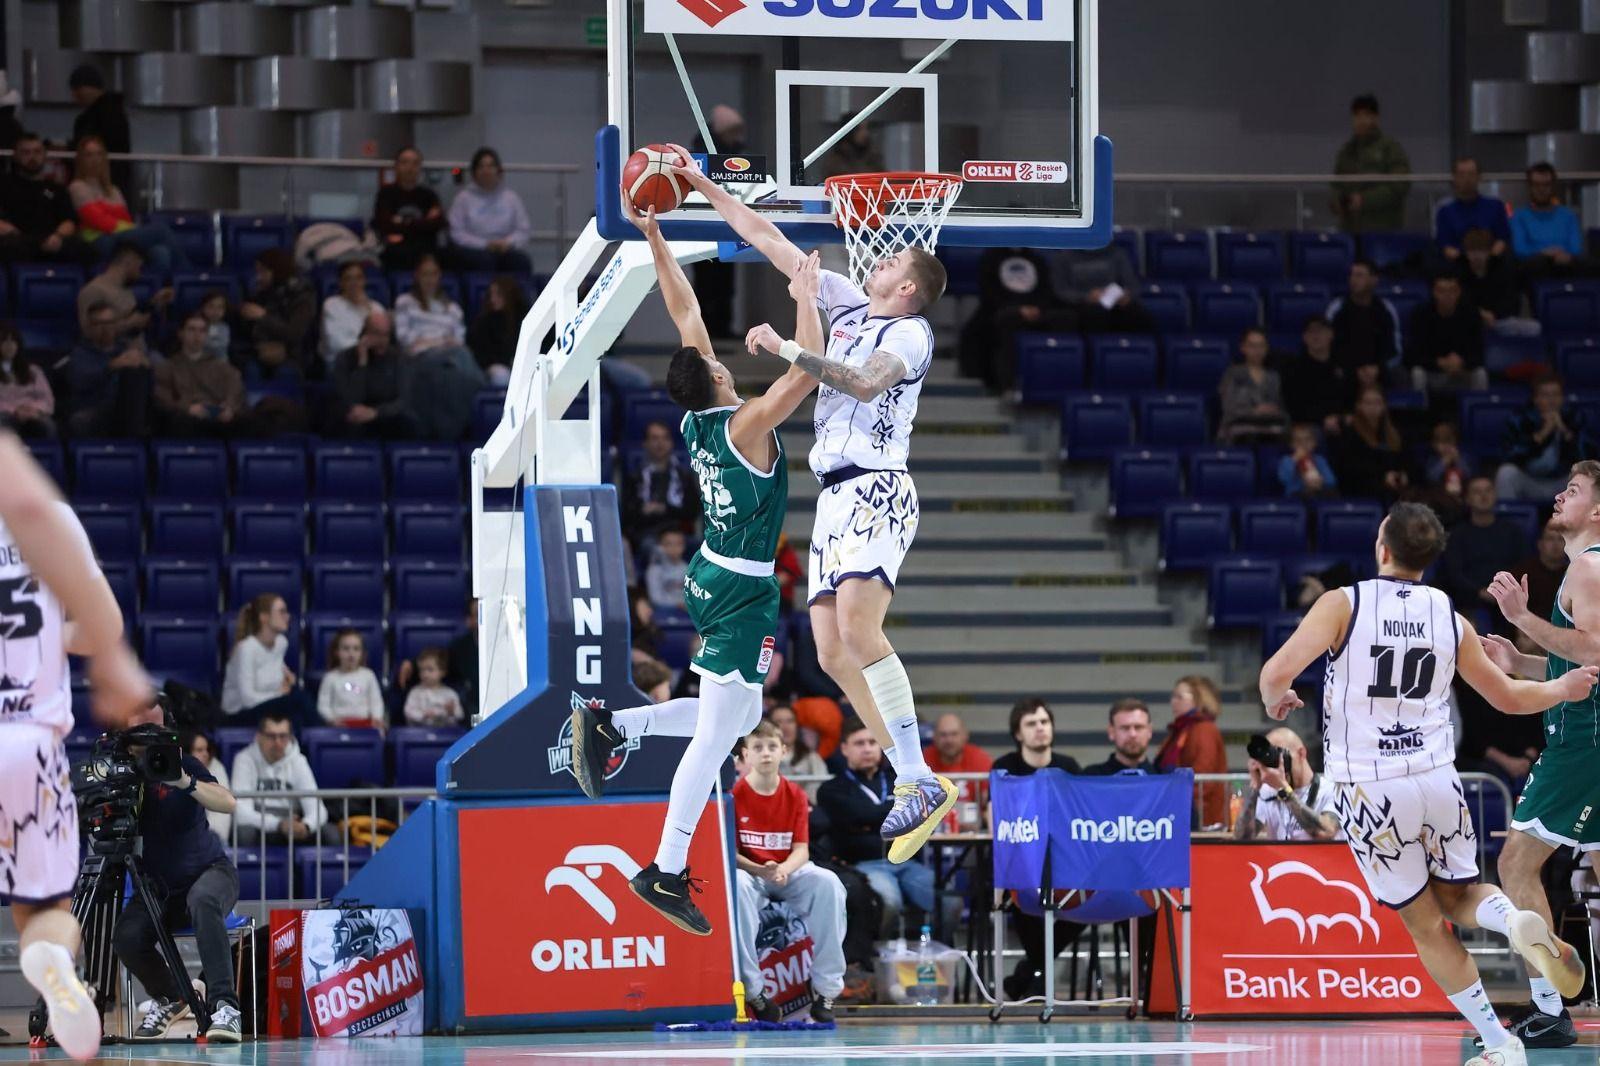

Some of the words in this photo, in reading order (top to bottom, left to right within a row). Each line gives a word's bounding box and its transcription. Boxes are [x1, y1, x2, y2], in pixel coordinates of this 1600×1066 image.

[711, 172, 764, 181] SMJSPORT.PL
[967, 165, 1012, 177] ORLEN
[1036, 164, 1063, 172] Basket
[562, 505, 603, 685] KING
[1396, 590, 1412, 599] 4F
[1383, 619, 1426, 639] NOVAK
[1367, 645, 1437, 699] 10
[1378, 732, 1424, 750] KING
[1071, 815, 1173, 843] molten
[531, 935, 666, 972] ORLEN
[314, 949, 419, 1027] BOSMAN
[1223, 967, 1311, 998] Bank
[1317, 967, 1422, 999] Pekao
[351, 1003, 407, 1035] SZCZECIŃSKI
